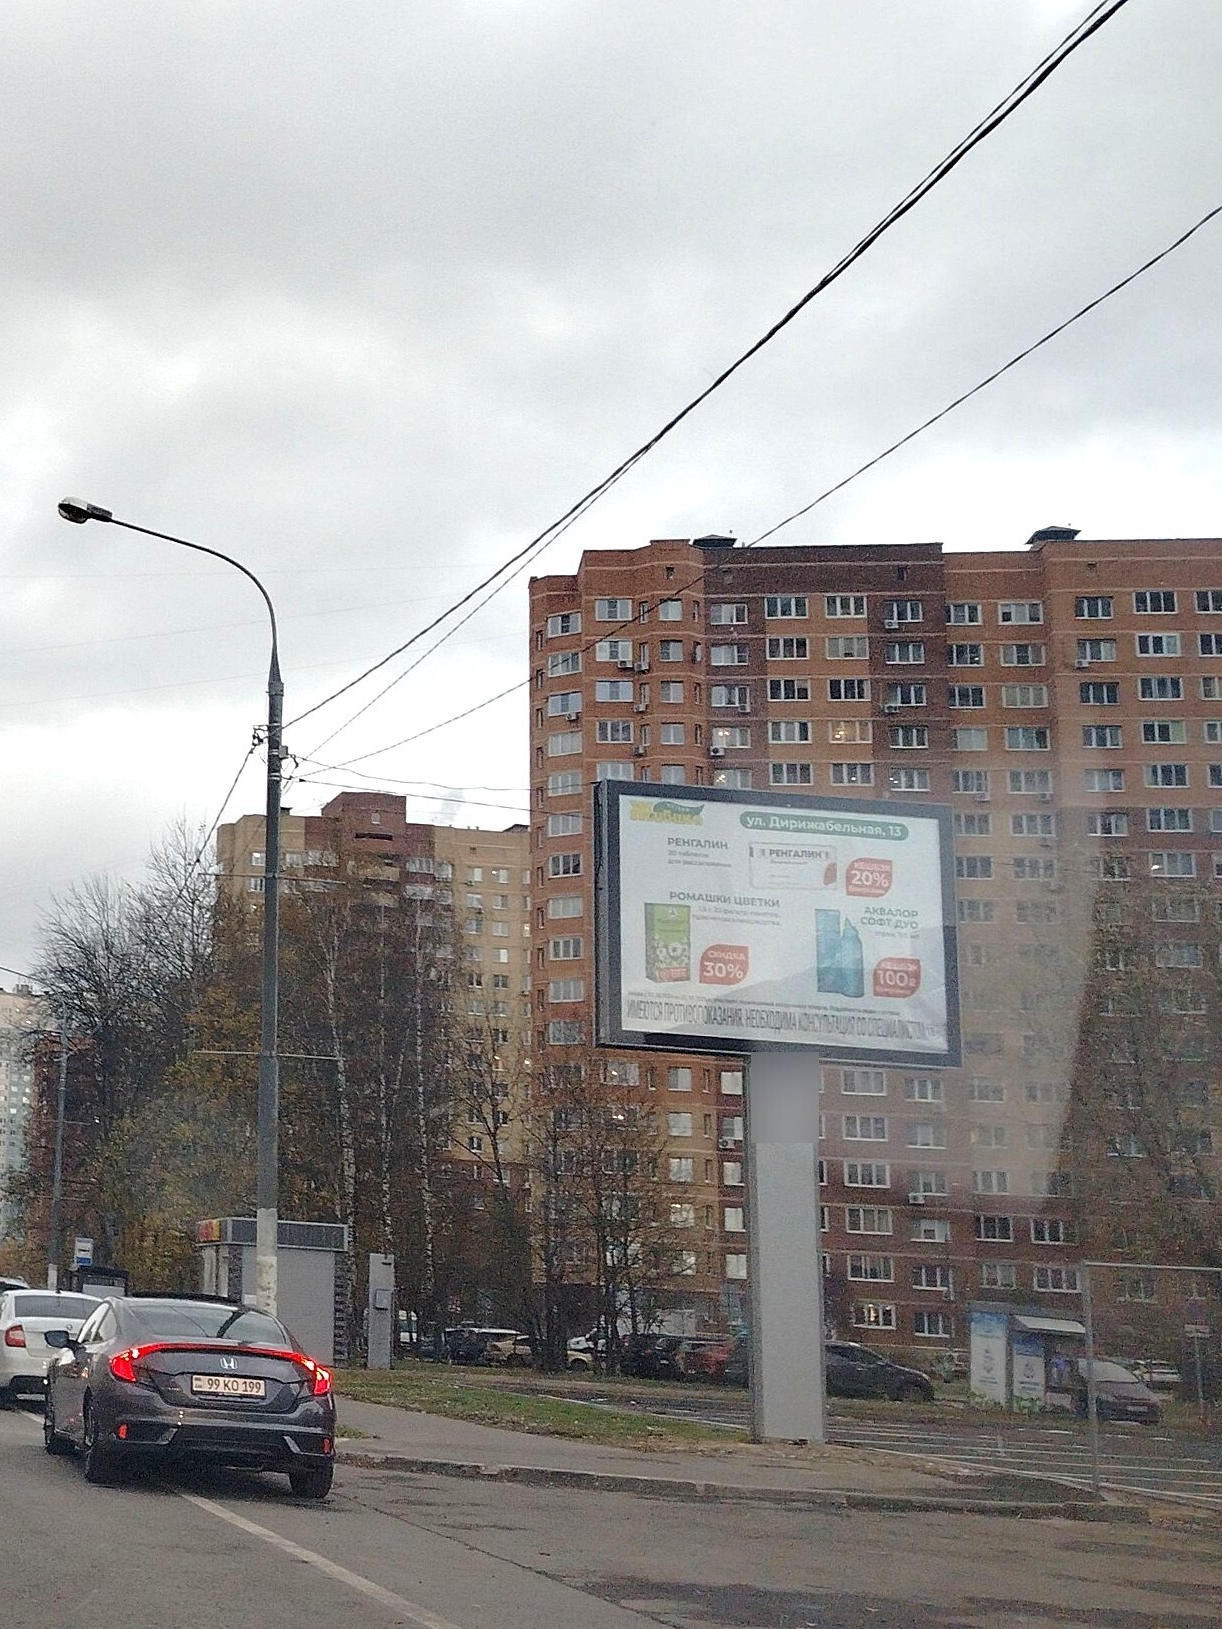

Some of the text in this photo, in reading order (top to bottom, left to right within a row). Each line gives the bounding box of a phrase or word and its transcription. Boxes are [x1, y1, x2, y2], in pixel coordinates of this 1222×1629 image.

[746, 816, 765, 827] ул.
[888, 826, 902, 837] 13
[667, 837, 728, 849] РЕНГАЛИН
[769, 849, 822, 859] РЕНГАЛИН
[851, 871, 889, 887] 20%
[669, 891, 780, 907] РОМАШКИ ЦВЕТКИ
[864, 906, 919, 918] АКВАЛОР
[860, 917, 919, 930] СОФТ ДУО
[708, 950, 745, 960] СКИДКА
[703, 962, 744, 979] 30%
[207, 1378, 221, 1390] 99
[223, 1379, 239, 1391] KO
[242, 1381, 261, 1393] 199
